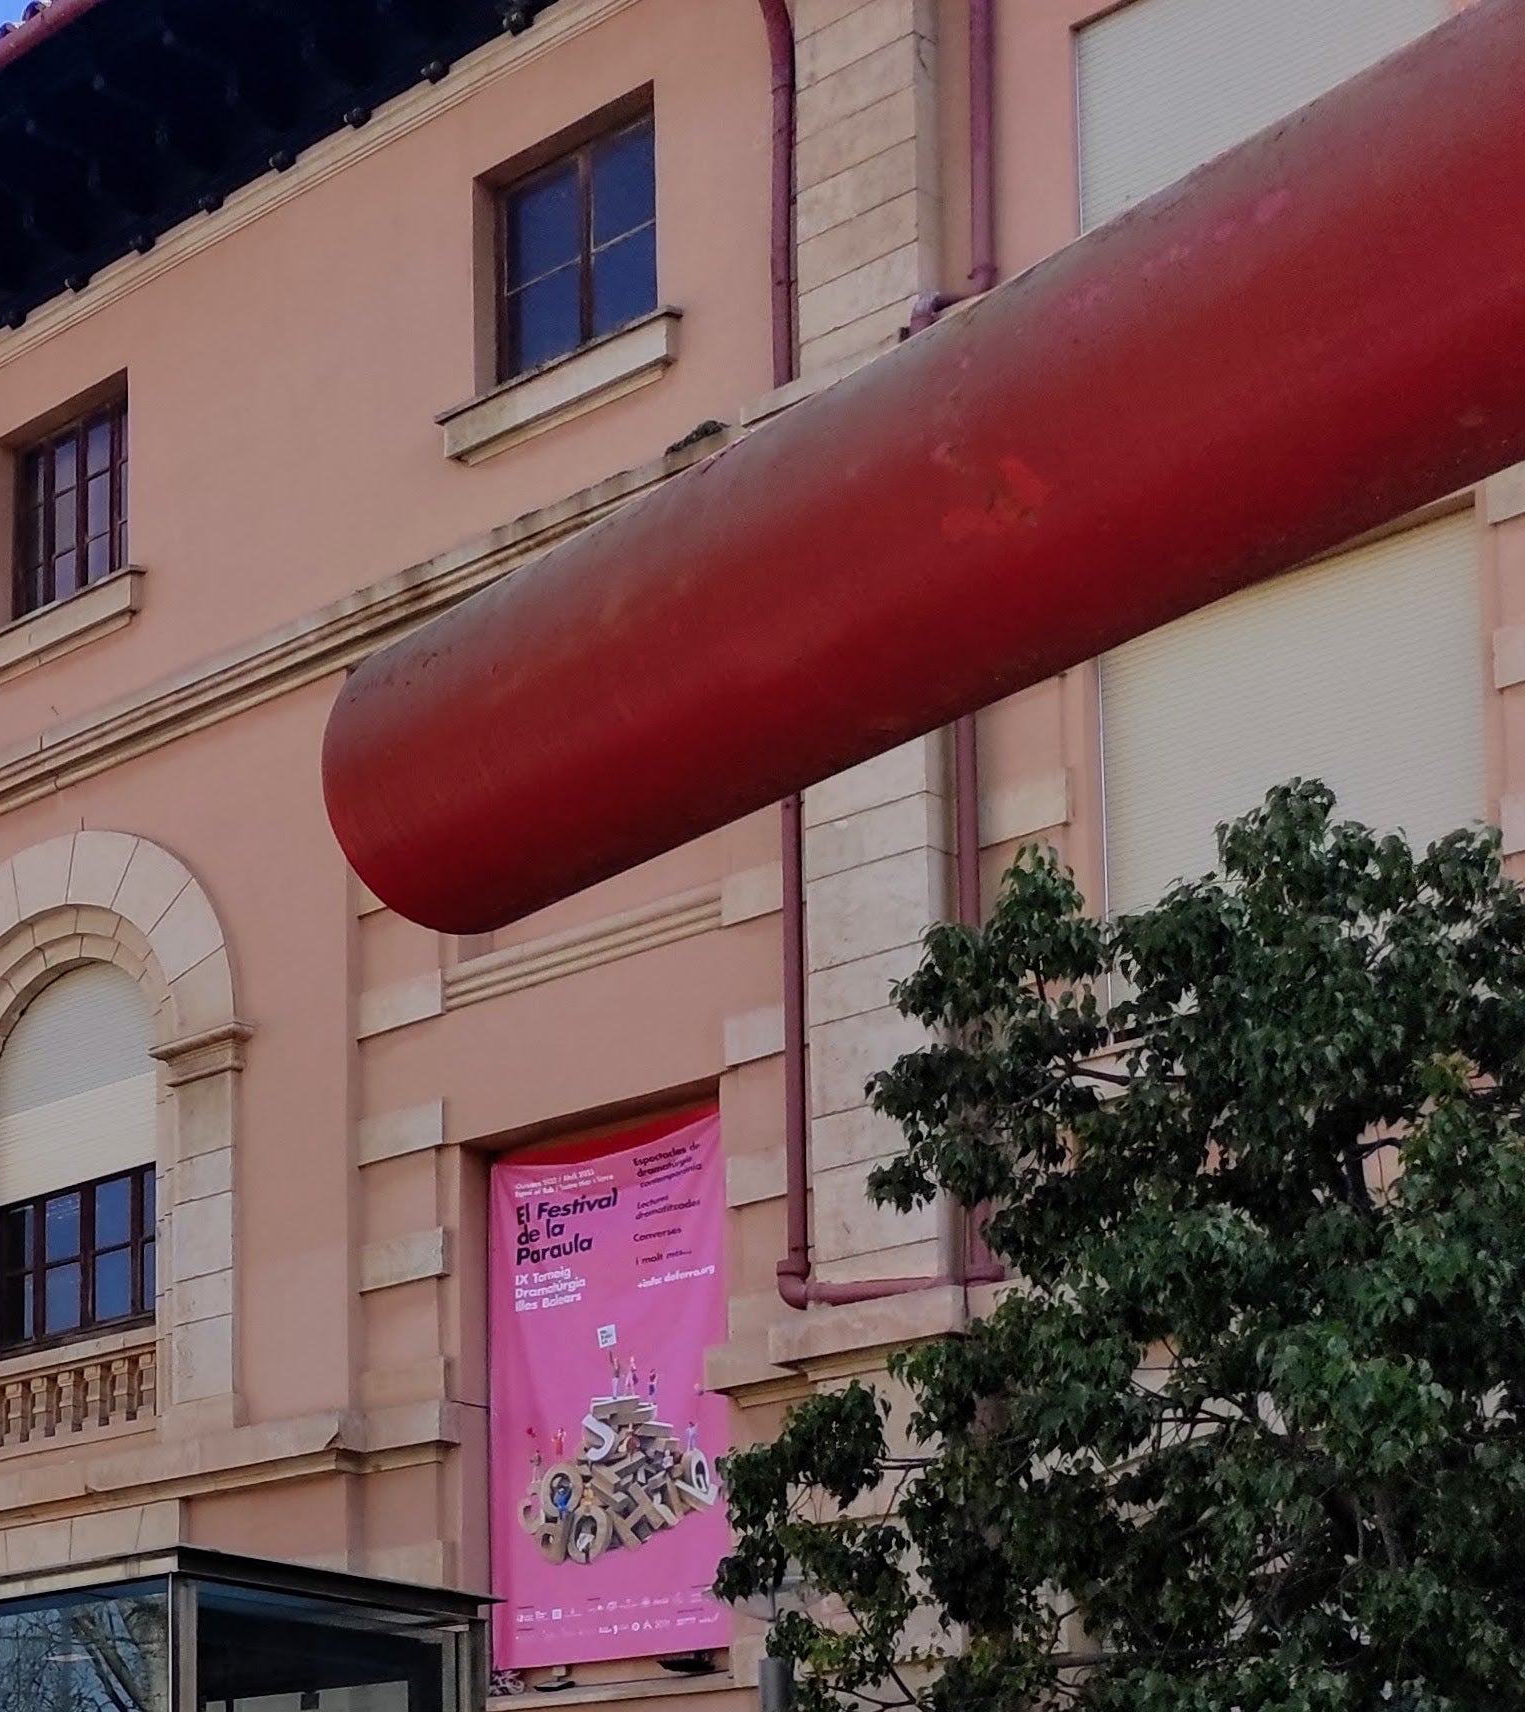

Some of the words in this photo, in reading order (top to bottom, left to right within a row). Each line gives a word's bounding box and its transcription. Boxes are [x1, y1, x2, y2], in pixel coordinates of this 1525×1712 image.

[516, 1202, 530, 1226] El
[537, 1187, 618, 1220] Festival
[517, 1223, 541, 1246] de
[546, 1218, 565, 1239] la
[633, 1227, 682, 1243] Converses
[516, 1232, 593, 1266] Paraula
[515, 1273, 529, 1286] IX
[542, 1292, 582, 1309] Balears
